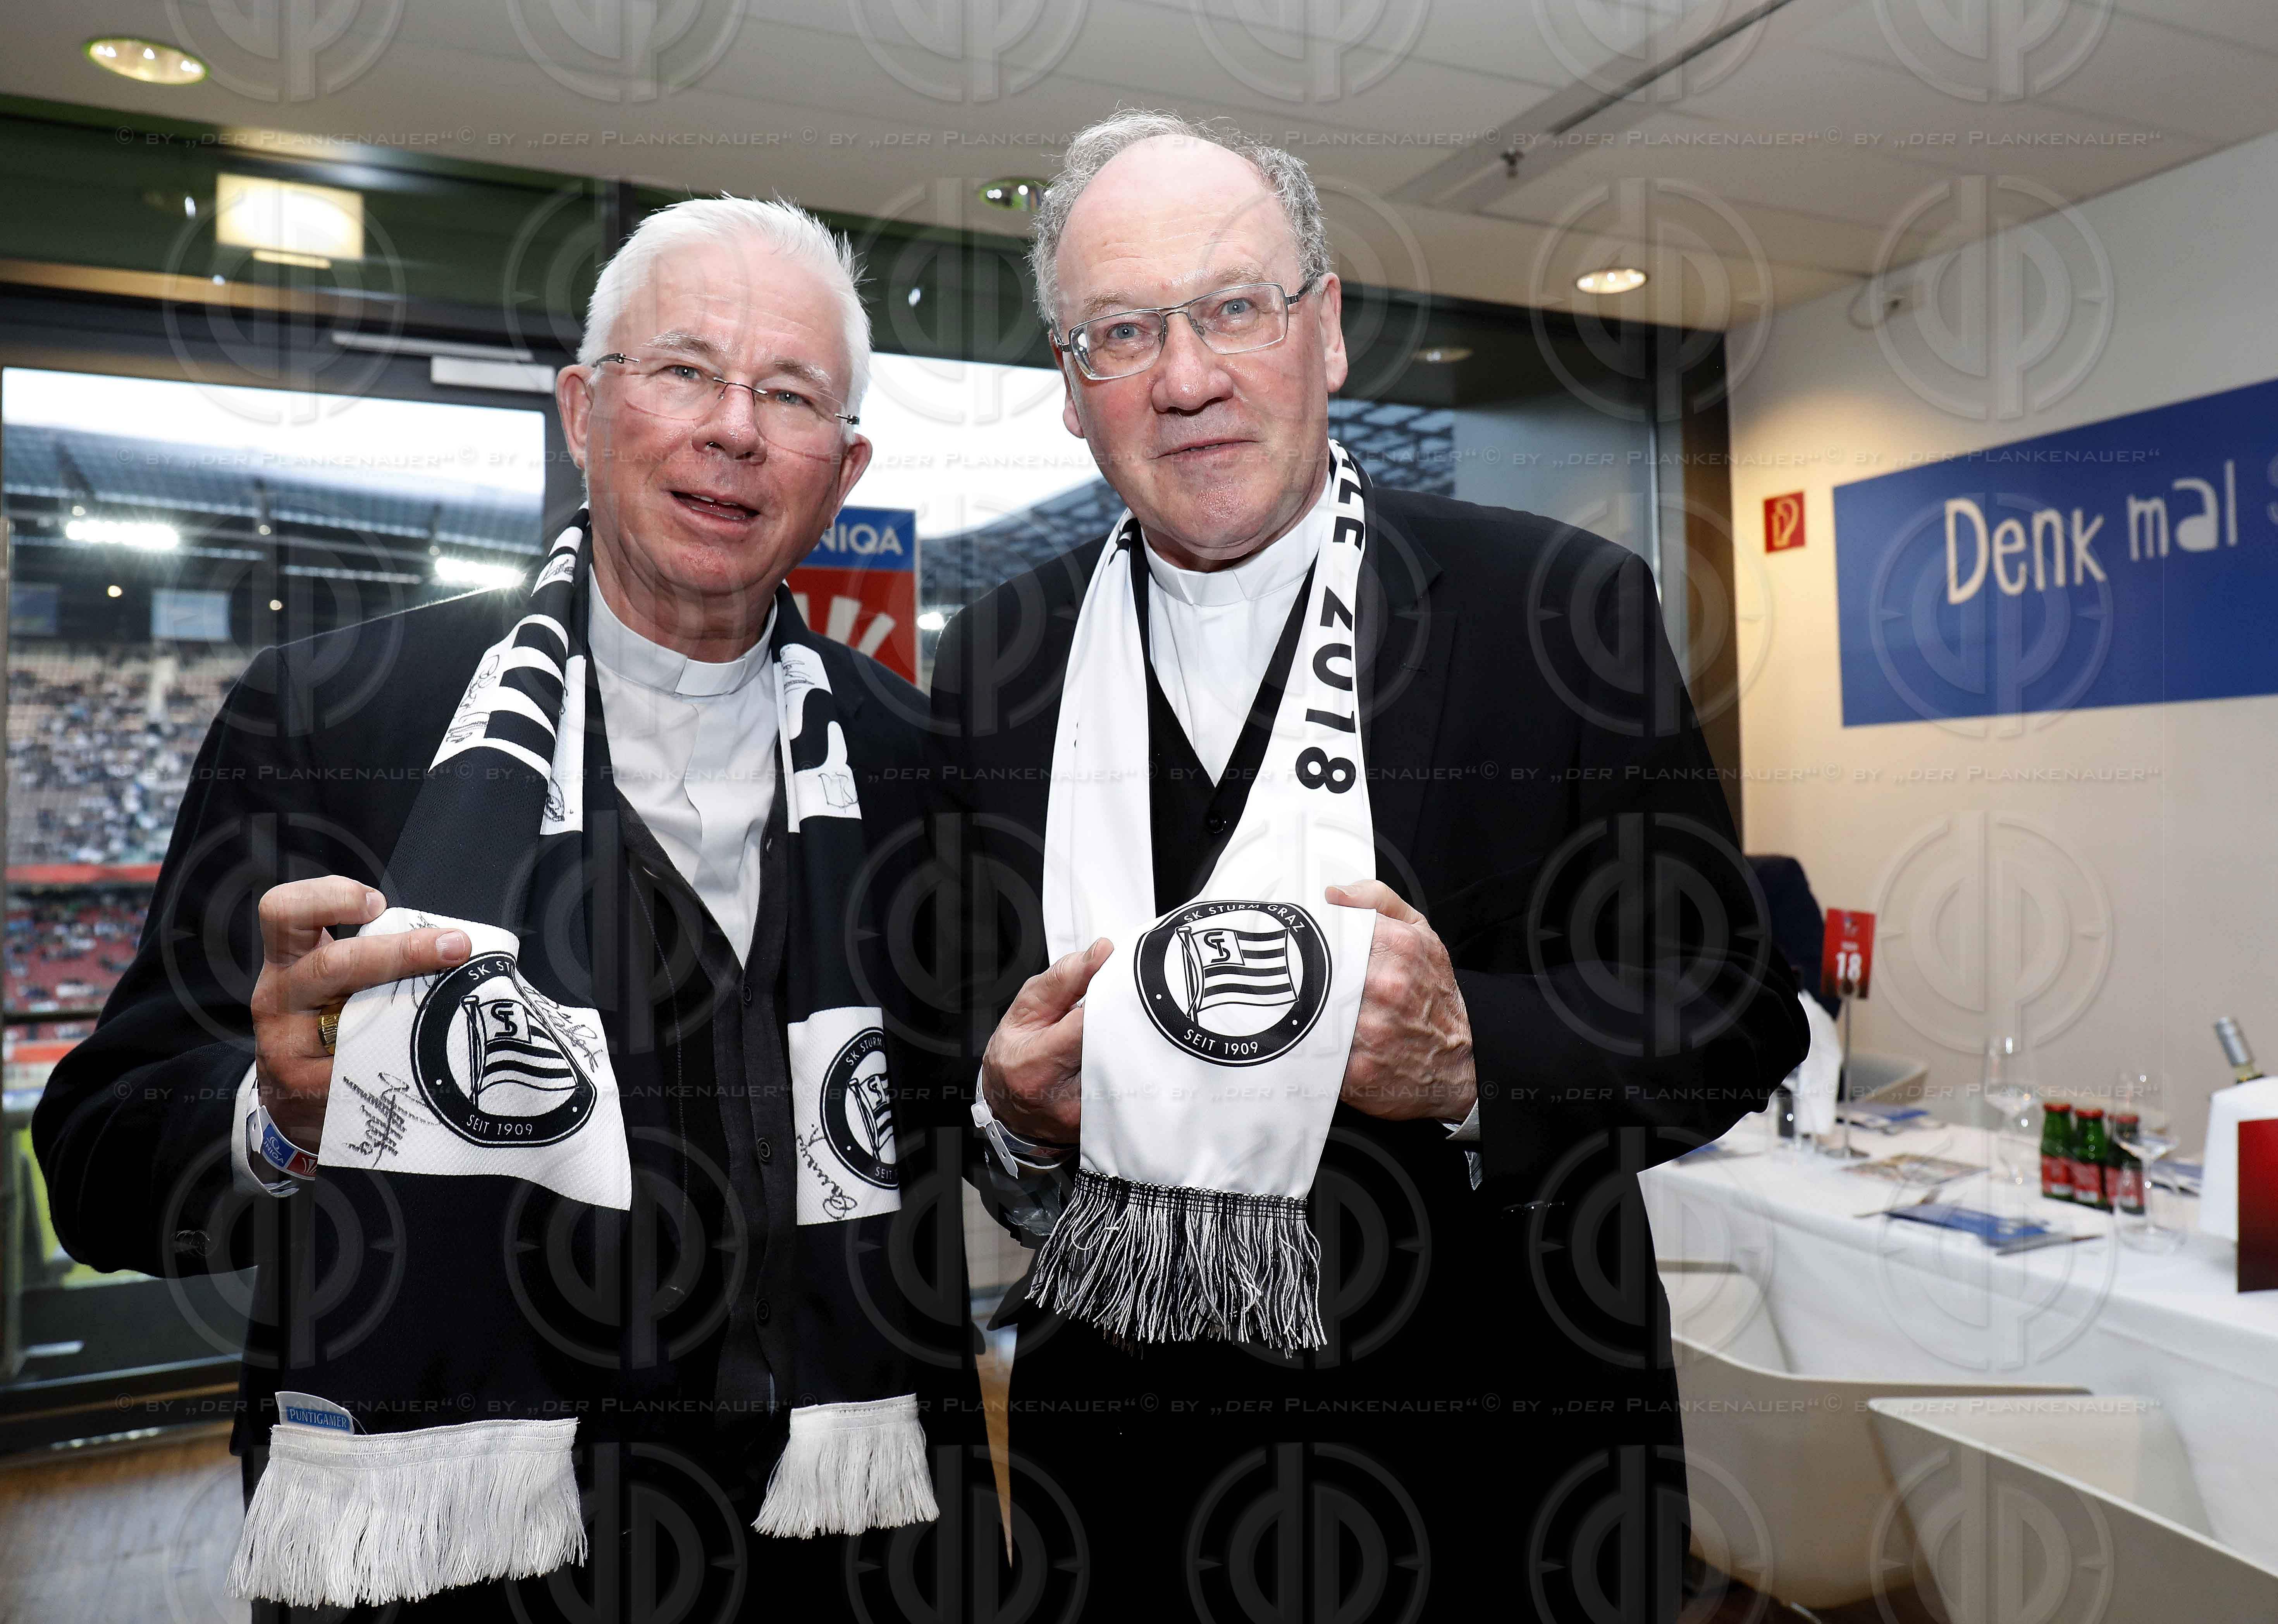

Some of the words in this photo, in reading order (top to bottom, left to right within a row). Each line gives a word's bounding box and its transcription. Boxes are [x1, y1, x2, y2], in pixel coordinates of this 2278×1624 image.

[814, 524, 903, 556] NIQA
[1945, 498, 2106, 605] Denk
[2126, 459, 2238, 561] mal
[1295, 585, 1356, 794] 2018
[1184, 910, 1203, 923] SK
[1209, 904, 1260, 914] STURM
[1267, 904, 1306, 933] GRAZ
[468, 964, 491, 980] SK
[1836, 952, 1862, 980] 18
[846, 1050, 860, 1066] SK
[860, 1037, 882, 1052] STURM
[1184, 1029, 1216, 1051] SEIT
[1224, 1041, 1258, 1055] 1909
[466, 1114, 490, 1134] SEIT
[497, 1123, 532, 1135] 1909
[875, 1166, 892, 1180] SEIT
[290, 1409, 347, 1428] PUNTIGAMER
